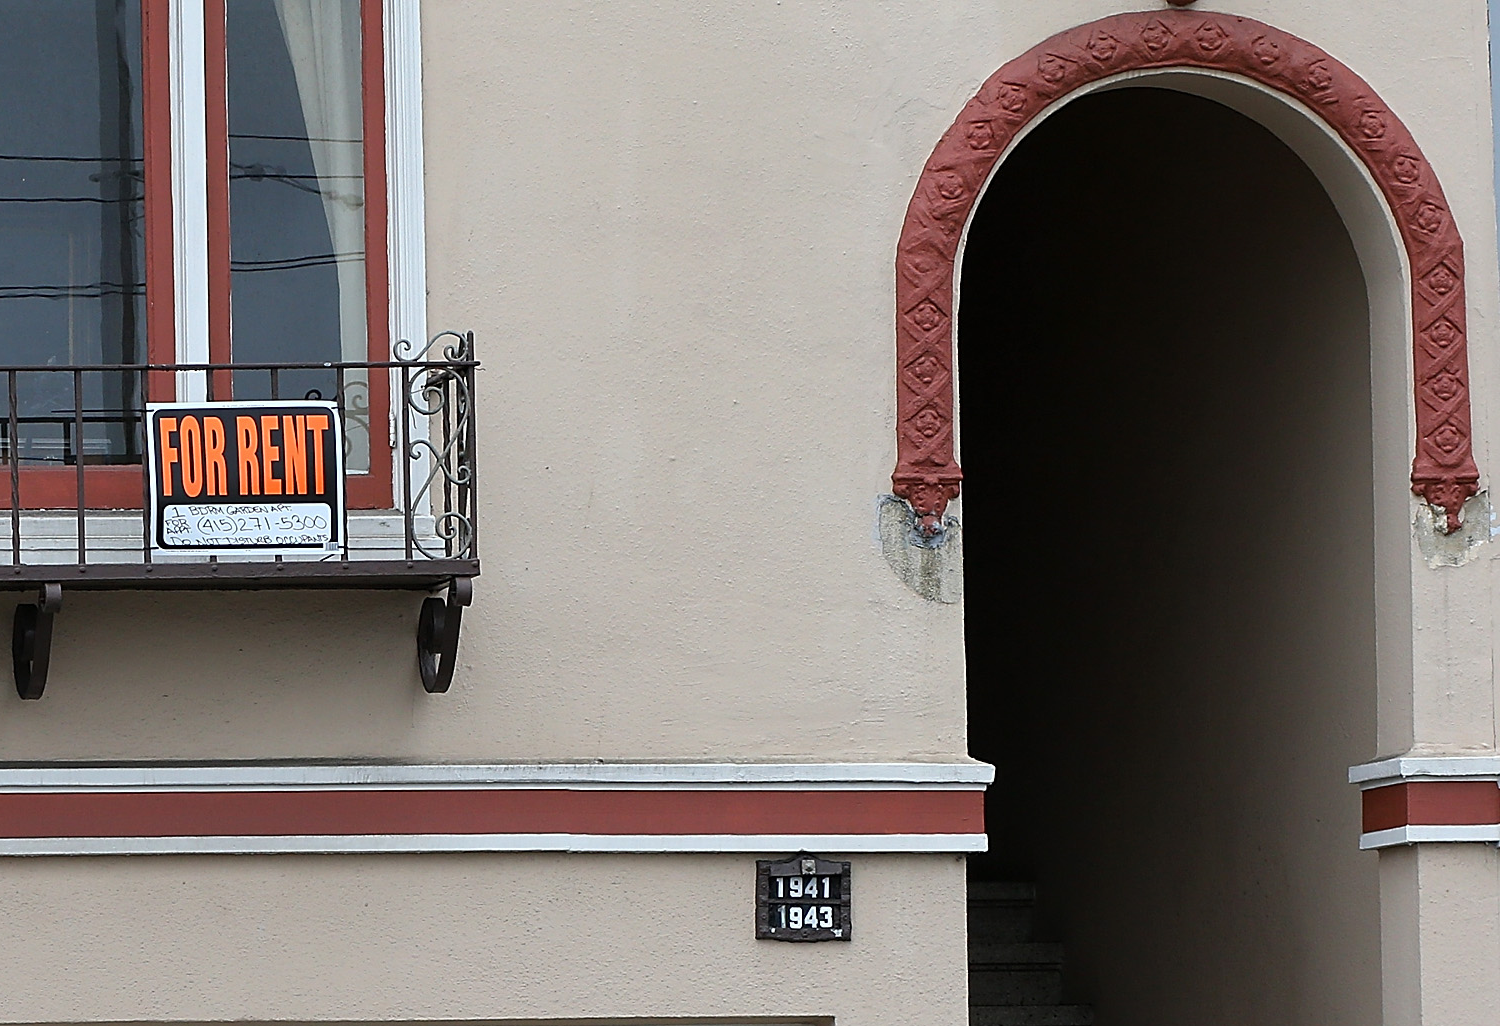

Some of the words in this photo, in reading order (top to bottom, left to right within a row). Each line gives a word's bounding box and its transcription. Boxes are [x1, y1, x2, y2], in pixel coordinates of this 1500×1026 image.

[159, 414, 228, 498] FOR
[236, 414, 329, 496] RENT
[171, 506, 185, 518] 1
[188, 505, 224, 516] BDRM
[226, 504, 269, 516] GARDEN
[270, 504, 292, 513] APT.
[165, 519, 189, 527] FOR
[196, 537, 221, 545] NOT
[222, 536, 272, 545] DISTURB
[276, 534, 329, 544] OCCUPANTS
[776, 877, 830, 898] 1941
[778, 905, 833, 929] 1943
